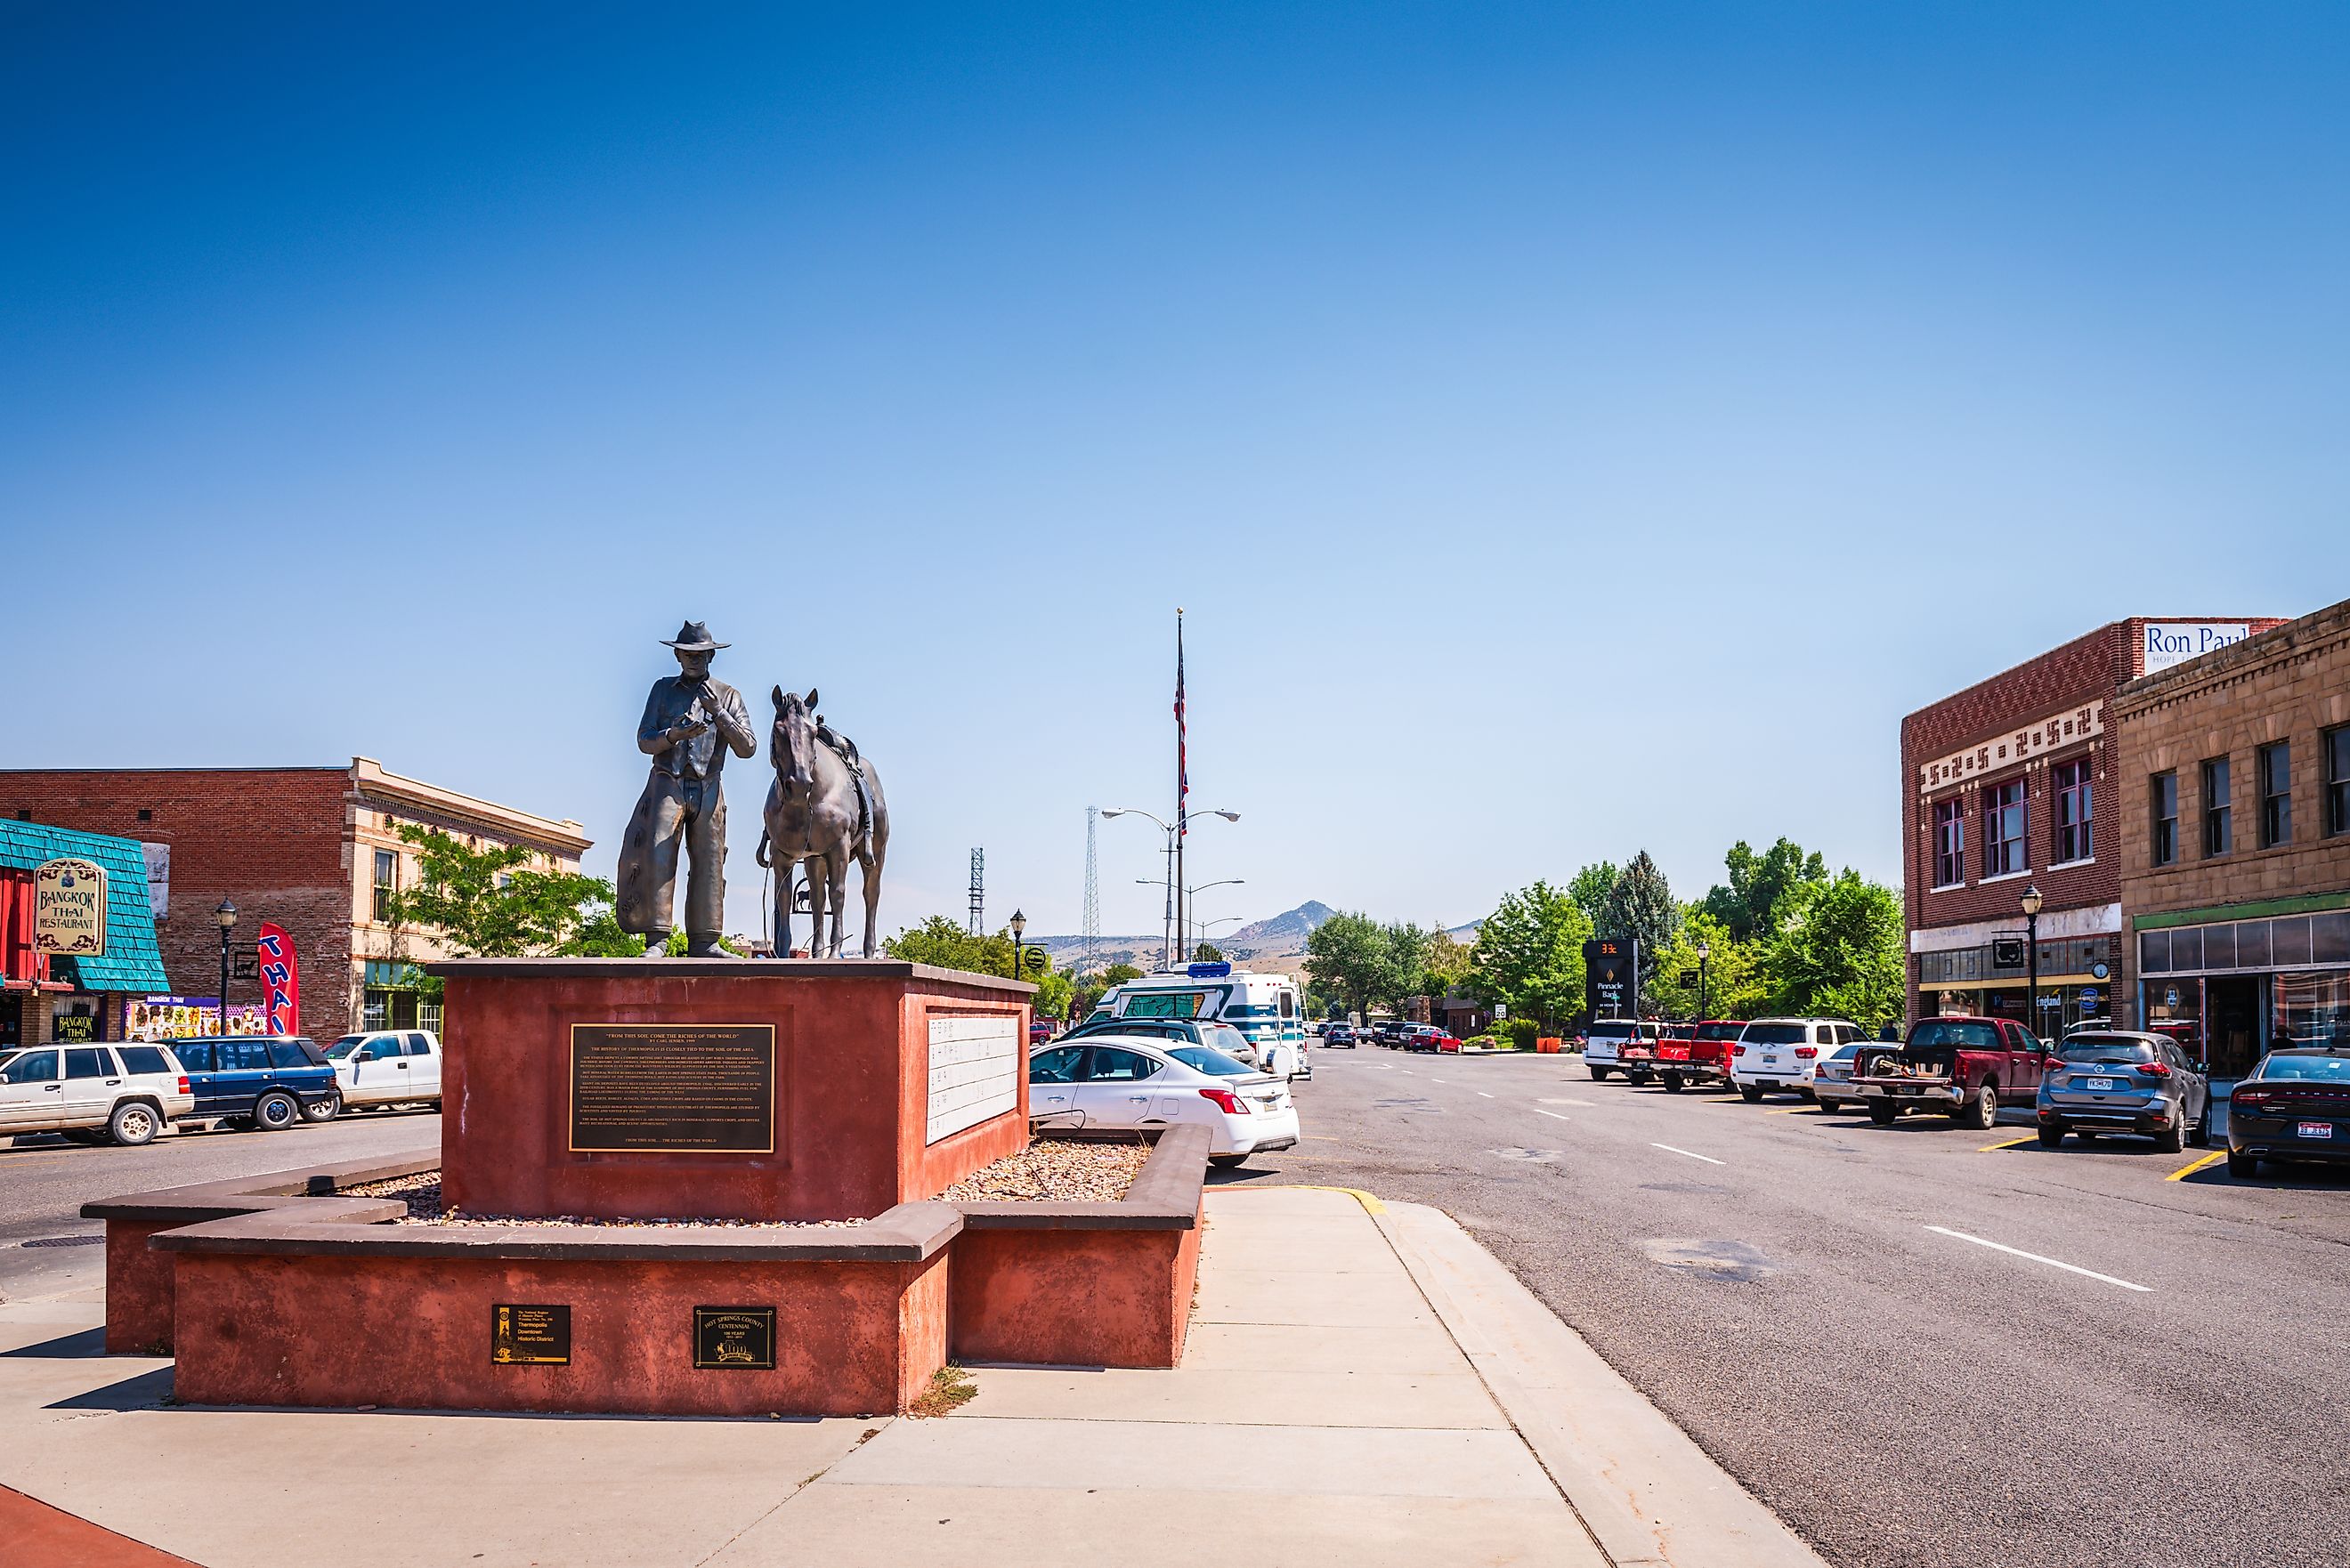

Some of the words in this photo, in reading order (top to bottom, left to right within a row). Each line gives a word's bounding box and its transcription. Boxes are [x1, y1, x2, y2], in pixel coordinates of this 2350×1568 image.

[2147, 627, 2191, 652] Ron
[40, 891, 95, 913] BANGKOK
[52, 907, 84, 917] THAI
[39, 917, 93, 929] RESTAURANT
[259, 934, 292, 1035] THAI
[1597, 982, 1624, 990] Pinnacle
[172, 996, 184, 1004] THAI
[2036, 994, 2061, 1010] England
[59, 1016, 93, 1032] BANGKOK
[67, 1028, 86, 1037] THAI
[704, 1319, 717, 1329] HOT
[741, 1316, 765, 1329] COUNTY
